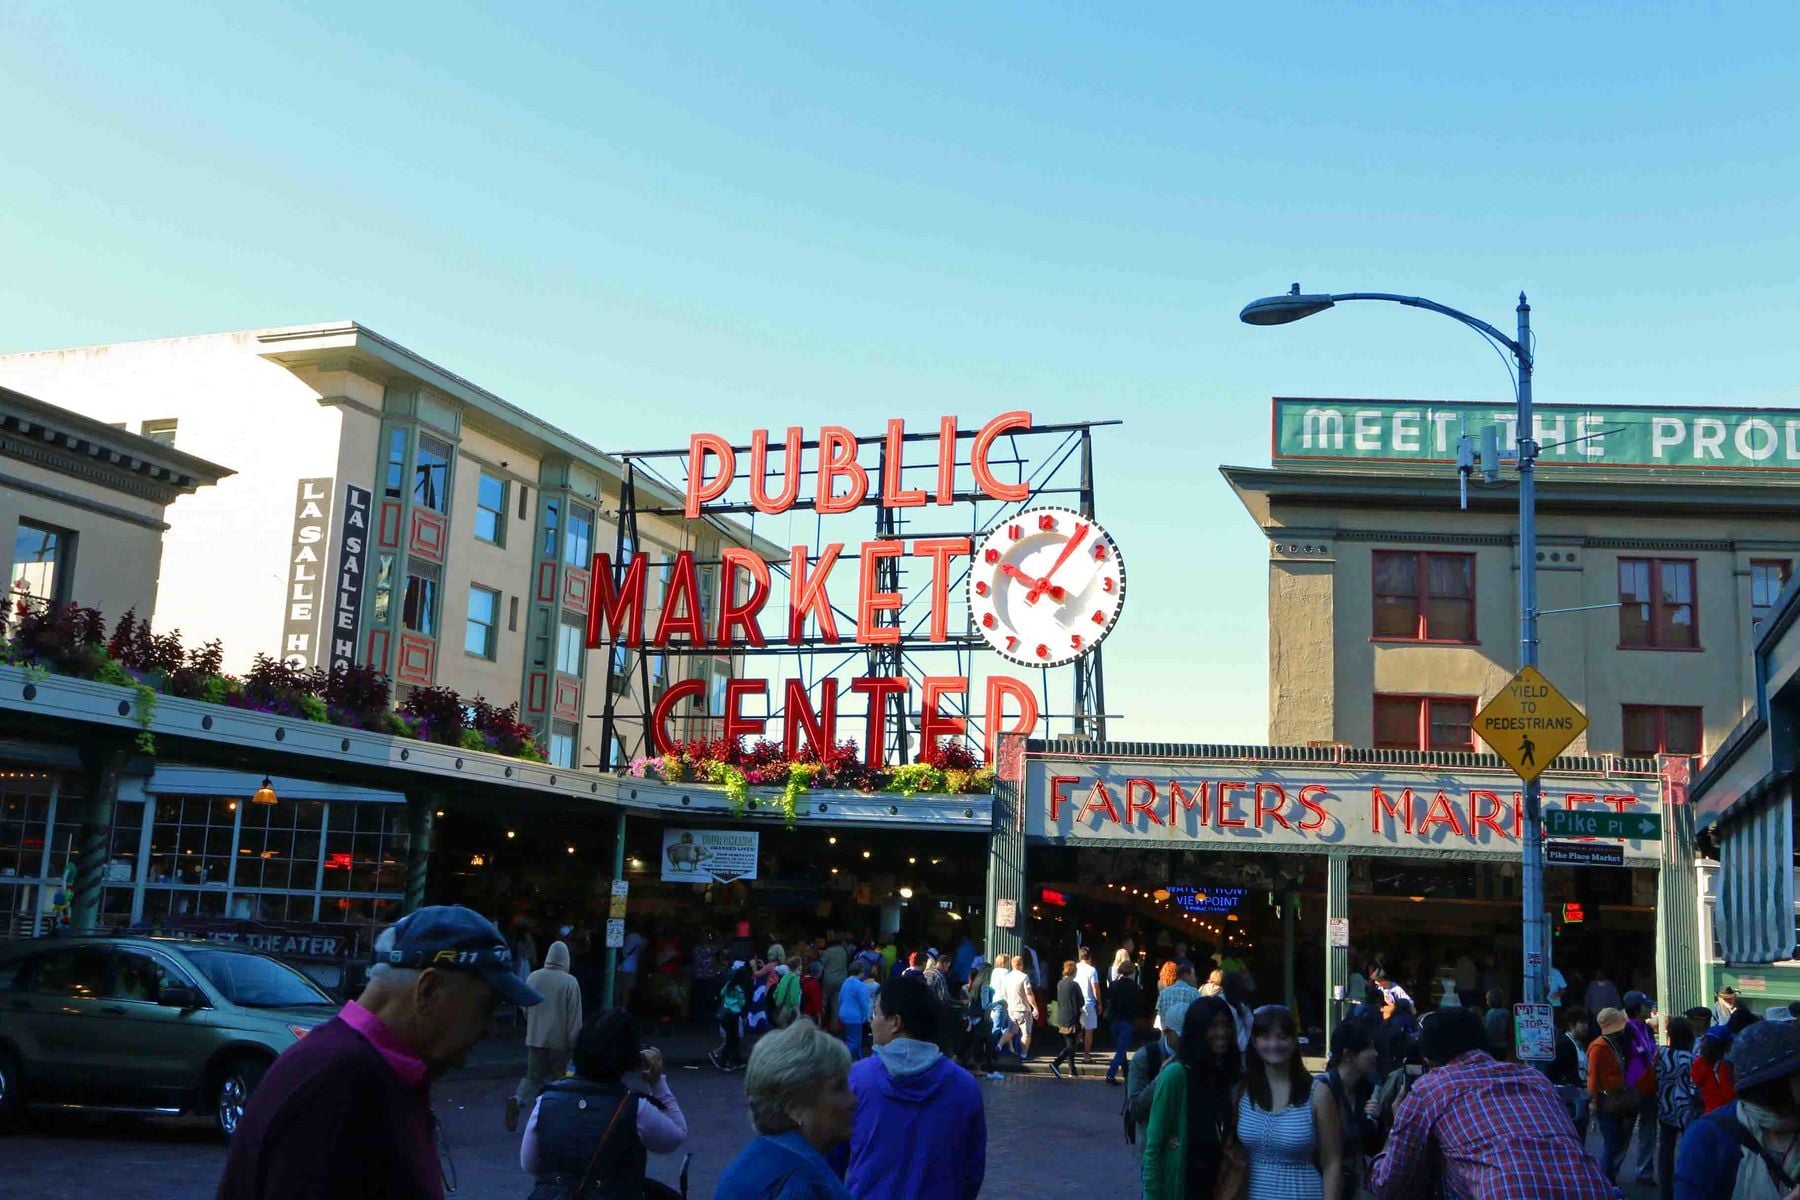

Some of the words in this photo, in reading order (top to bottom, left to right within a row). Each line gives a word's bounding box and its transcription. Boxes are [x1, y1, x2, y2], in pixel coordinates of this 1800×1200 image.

[1302, 408, 1456, 451] MEET
[686, 411, 1032, 519] PUBLIC
[348, 489, 366, 529] LA
[1039, 515, 1054, 530] 12
[1009, 525, 1019, 539] 11
[985, 549, 1000, 563] 10
[1095, 545, 1105, 560] 2
[290, 526, 323, 621] SALLE
[338, 537, 362, 630] SALLE
[976, 581, 987, 595] 9
[1103, 577, 1112, 592] 3
[586, 538, 972, 649] MARKET
[983, 613, 993, 628] 8
[1092, 610, 1104, 624] 4
[1006, 636, 1017, 650] 7
[1071, 635, 1081, 649] 5
[1036, 644, 1048, 658] 6
[1510, 686, 1549, 698] YIELD
[1521, 702, 1537, 714] TO
[653, 676, 1039, 769] CENTER
[1485, 717, 1573, 730] PEDESTRIANS
[1050, 776, 1330, 831] FARMERS
[1553, 812, 1598, 833] Pike
[1608, 820, 1623, 834] Pl
[1550, 851, 1568, 859] Pike
[1569, 852, 1590, 861] Place
[1592, 853, 1621, 862] Market
[245, 933, 337, 956] THEATER
